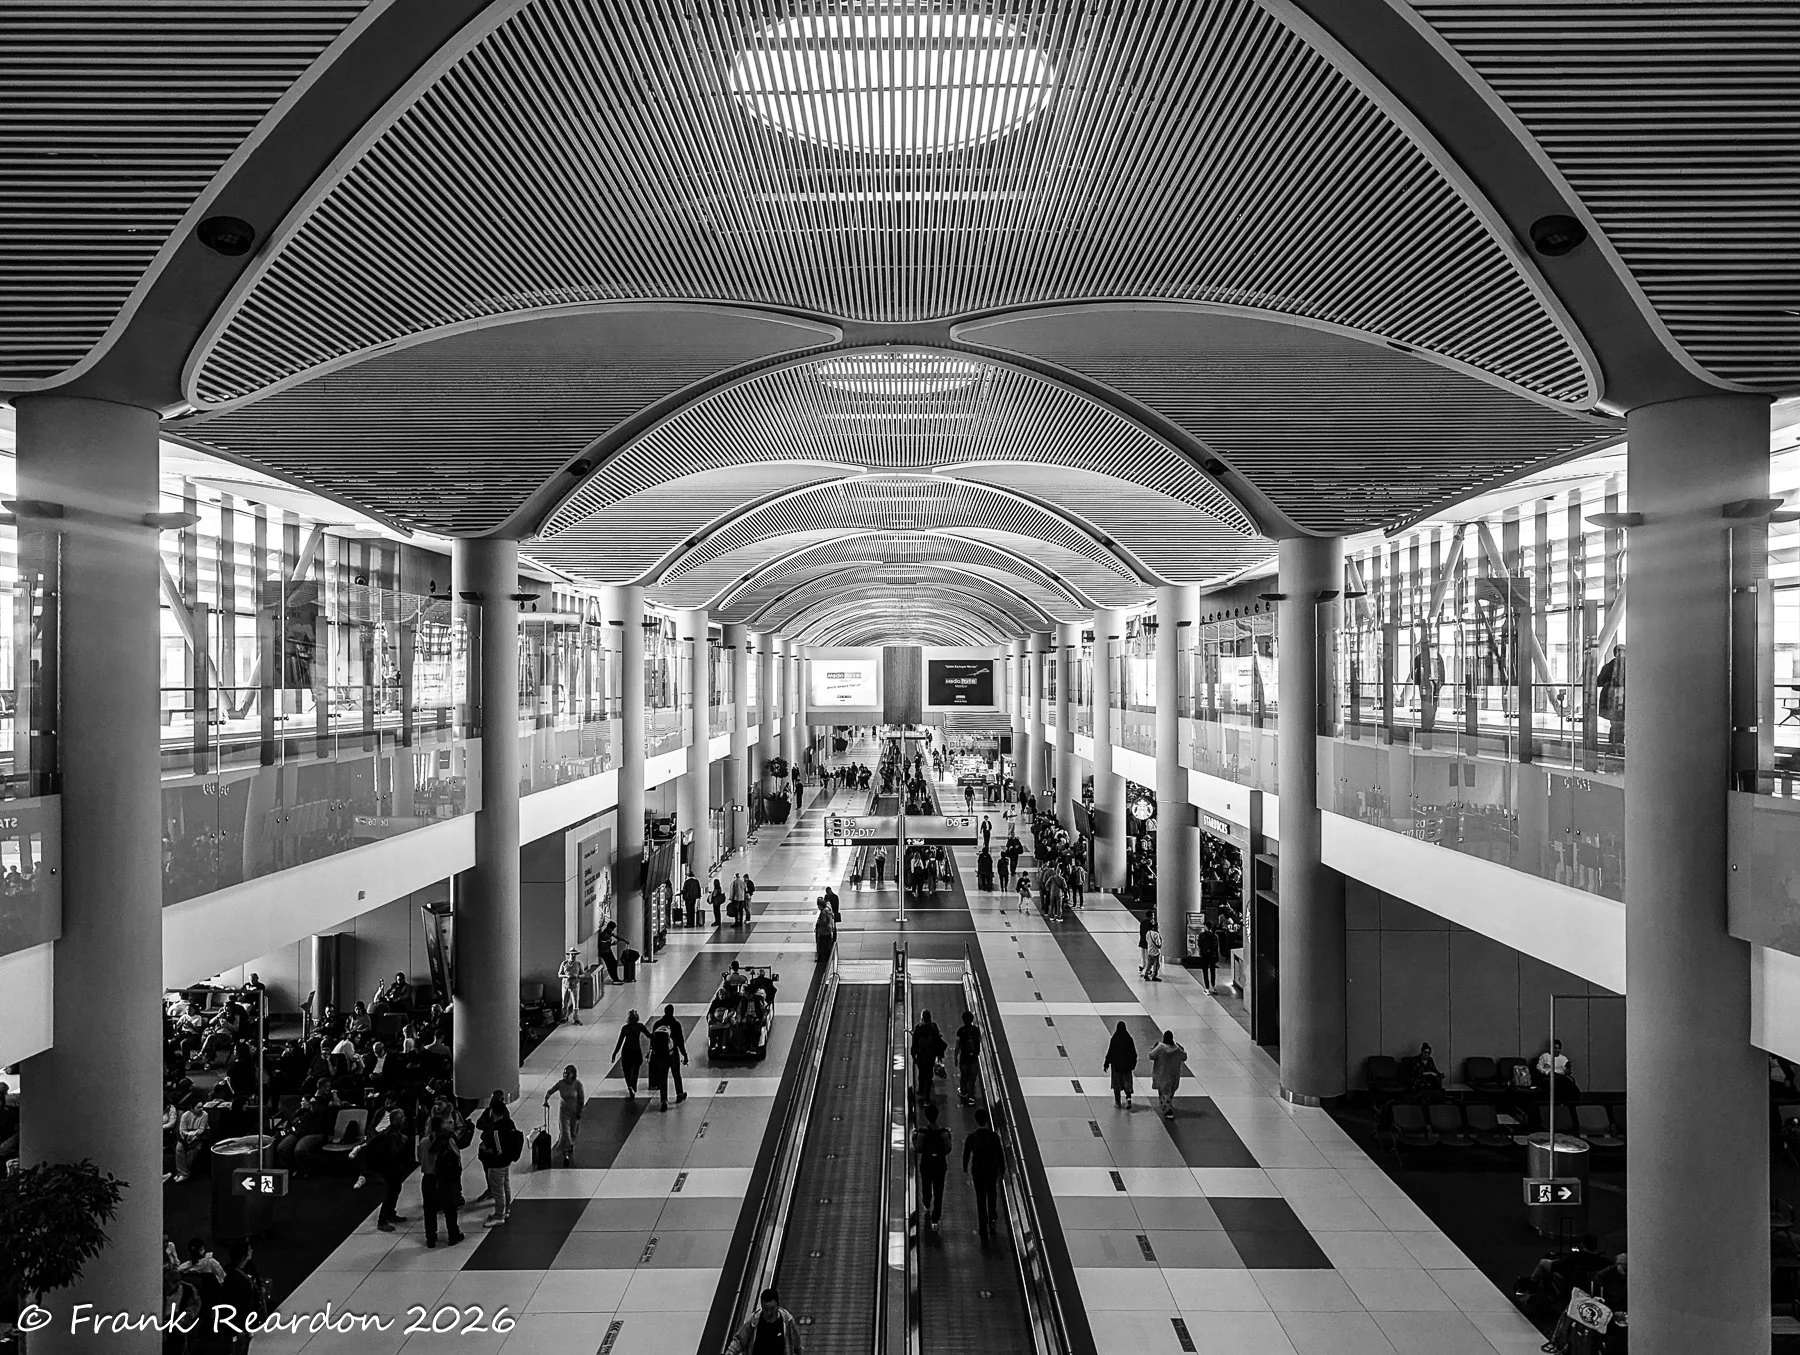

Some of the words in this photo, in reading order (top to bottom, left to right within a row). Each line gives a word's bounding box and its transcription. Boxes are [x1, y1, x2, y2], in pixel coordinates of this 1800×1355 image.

[843, 818, 856, 827] D5
[946, 818, 959, 827] D6
[1203, 814, 1228, 835] STARBUCKS
[843, 828, 876, 837] D7-D17
